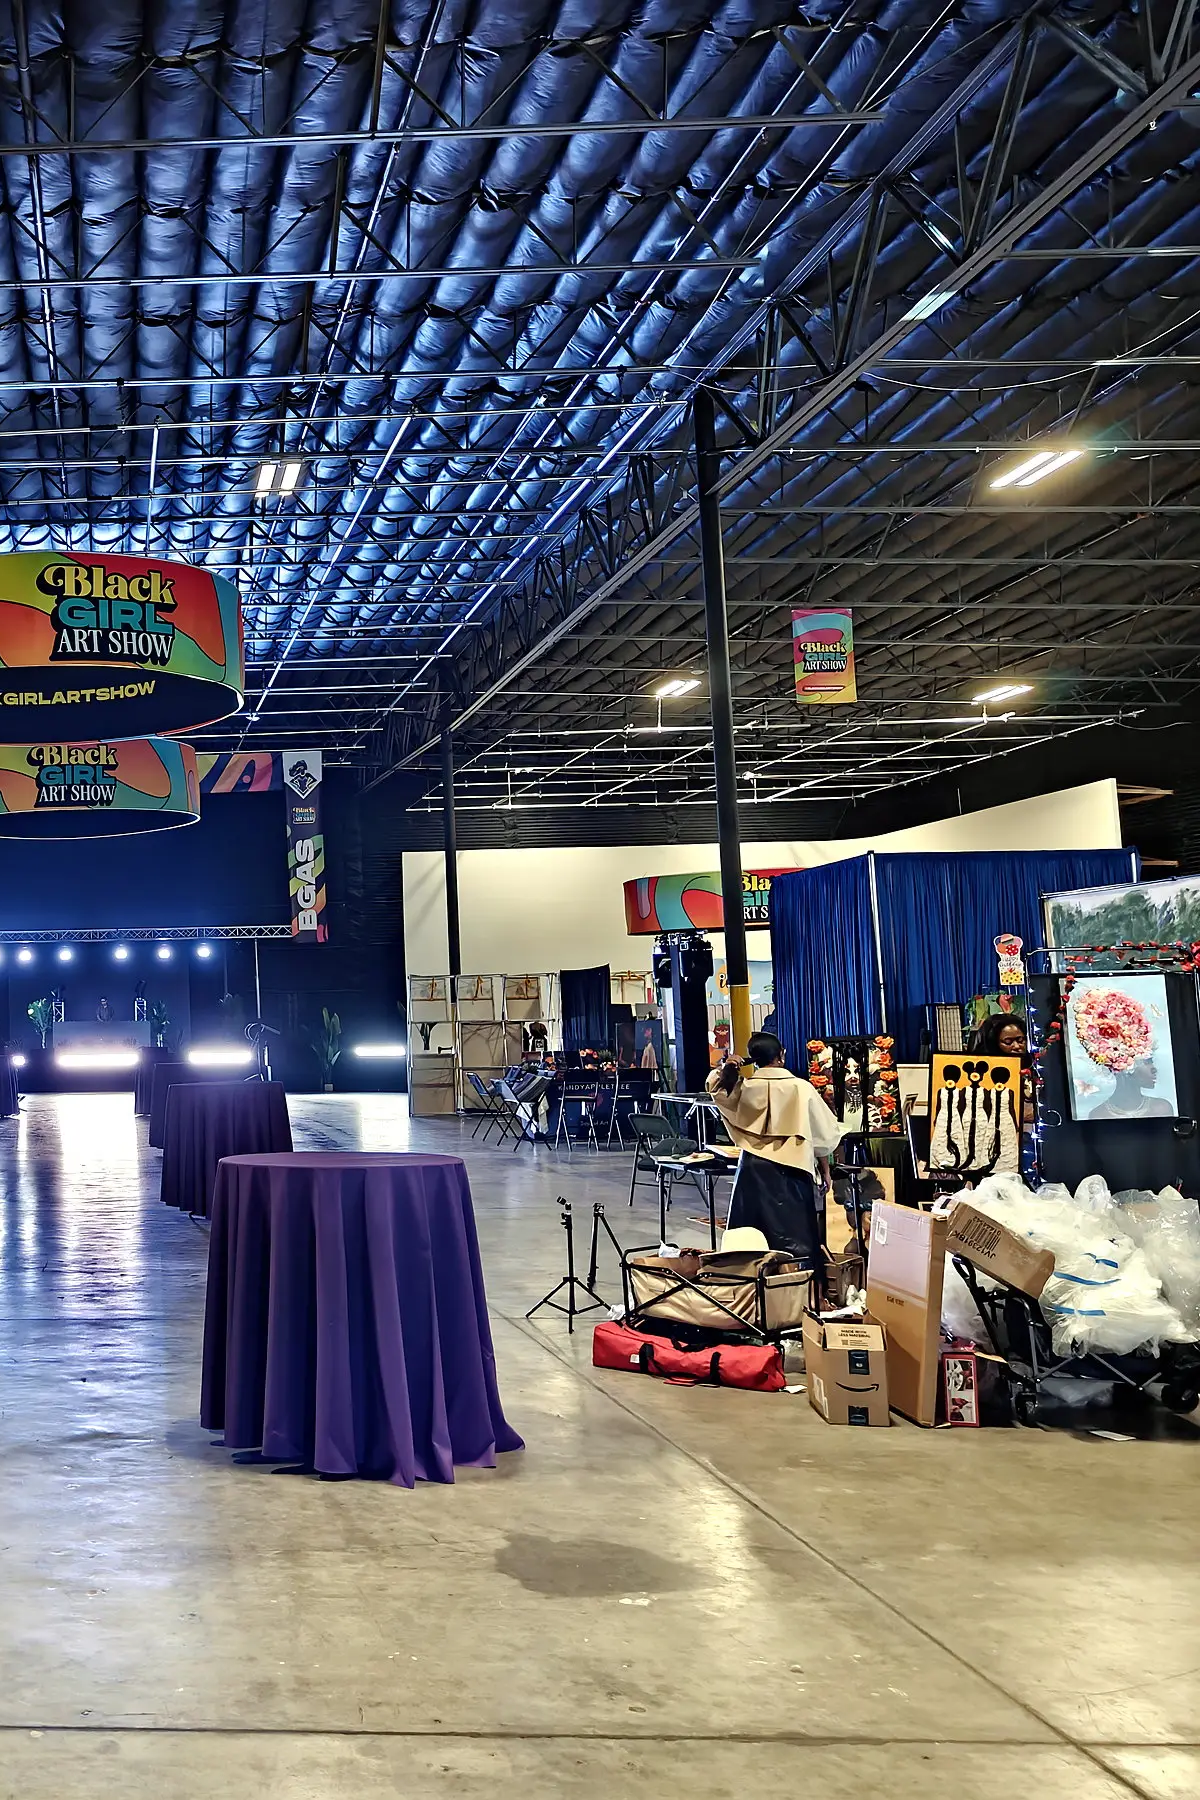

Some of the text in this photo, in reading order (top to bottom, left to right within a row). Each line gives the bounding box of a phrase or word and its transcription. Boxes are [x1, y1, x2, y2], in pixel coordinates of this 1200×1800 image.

[44, 566, 175, 604] Black
[58, 598, 173, 634] GIRL
[57, 629, 172, 659] ART SHOW
[800, 642, 846, 653] Black
[804, 653, 847, 661] GIRL
[804, 661, 847, 670] ART SHOW
[31, 745, 116, 766] Black
[40, 765, 116, 786] GIRL
[39, 785, 116, 802] ART SHOW
[294, 838, 318, 931] BGAS
[558, 1083, 630, 1091] KANDYAPLETEE
